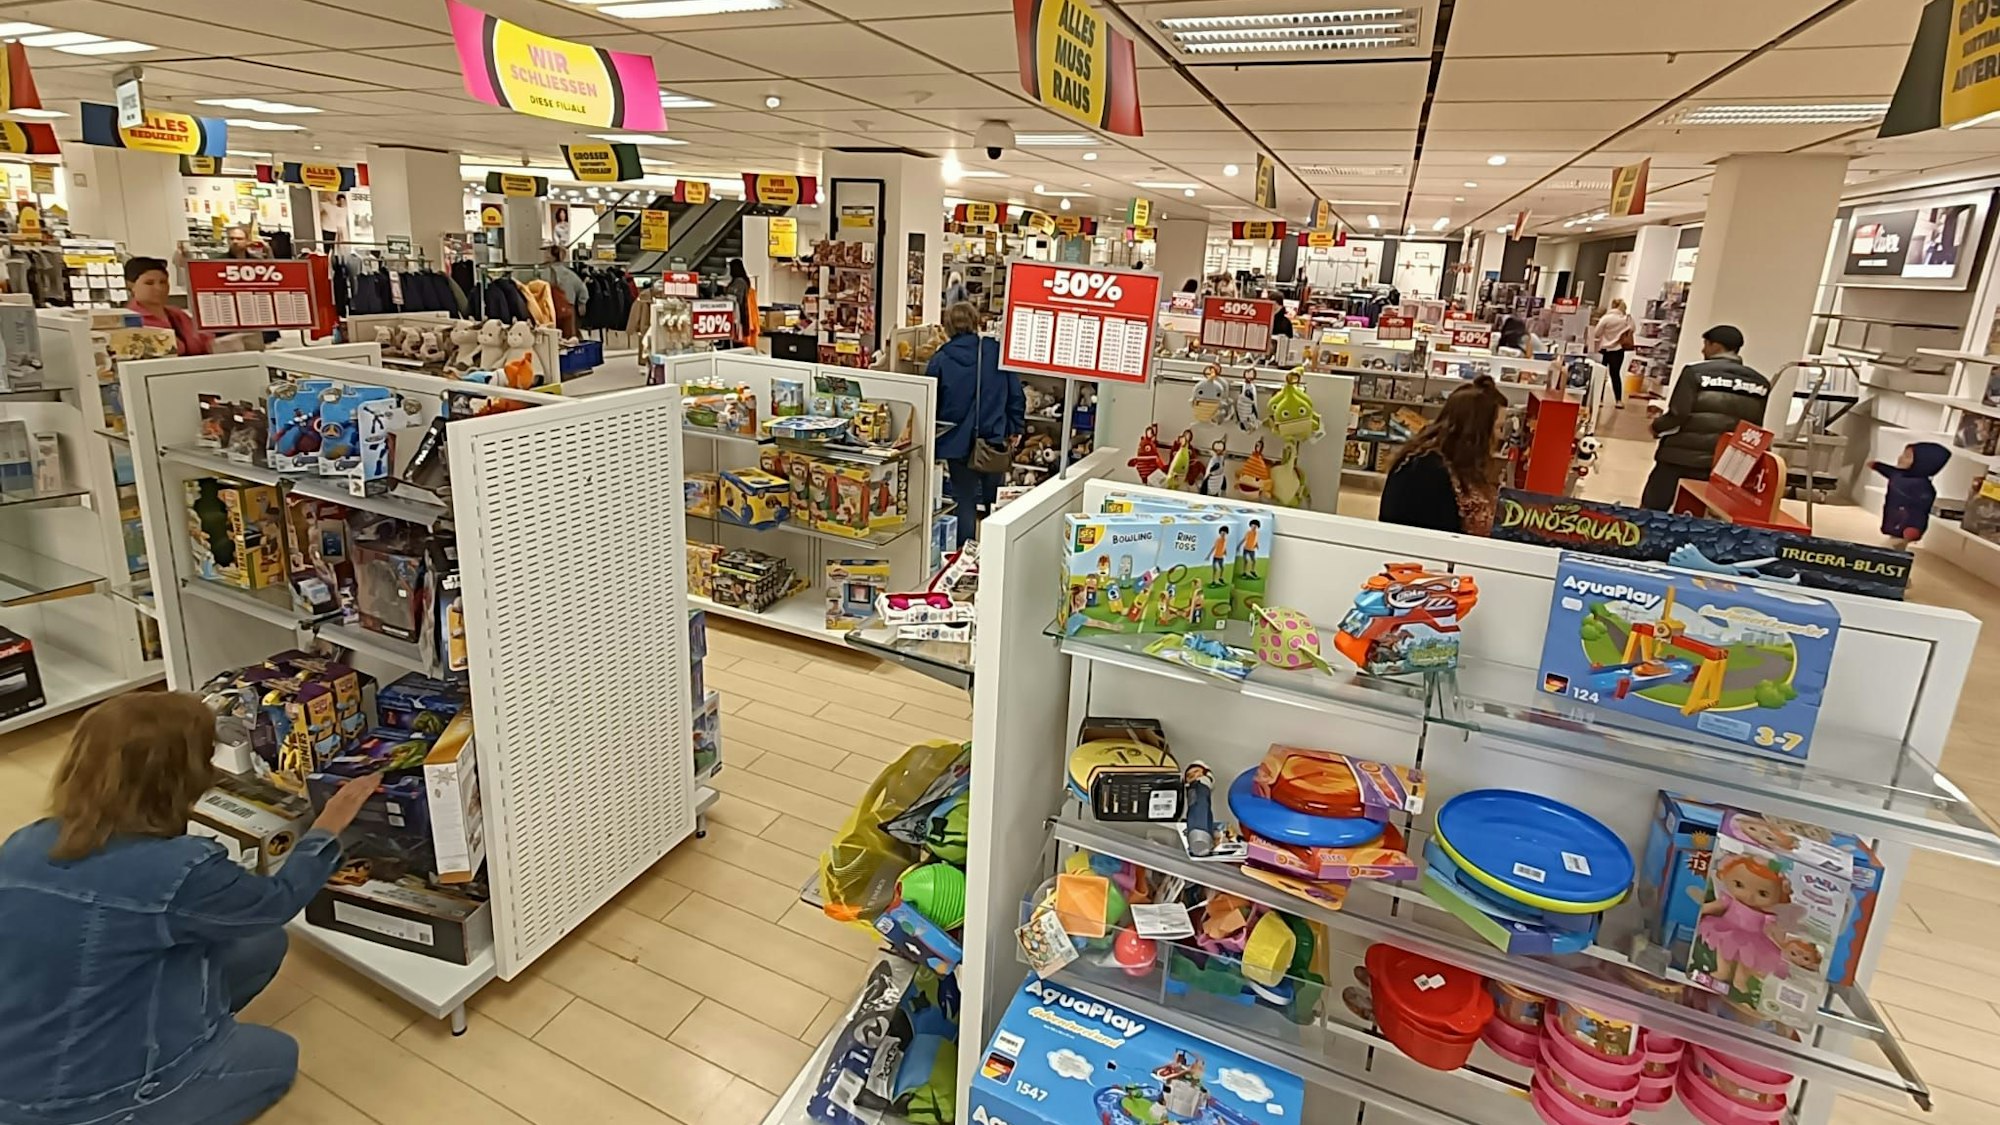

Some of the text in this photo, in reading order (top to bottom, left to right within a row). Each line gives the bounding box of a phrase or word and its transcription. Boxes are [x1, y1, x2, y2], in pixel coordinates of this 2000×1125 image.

[1058, 0, 1095, 48] ALLES
[527, 44, 570, 75] WIR
[1055, 34, 1091, 81] MUSS
[510, 64, 598, 98] SCHLIESSEN
[1053, 69, 1090, 114] RAUS
[530, 95, 587, 114] DIESE FILIALE
[139, 115, 188, 133] LLES
[130, 129, 189, 143] REDUZIERT
[306, 167, 336, 176] ALLES
[217, 265, 283, 282] -50%
[1043, 269, 1123, 301] -50%
[1219, 301, 1257, 317] -50%
[693, 314, 731, 334] -50%
[1455, 331, 1489, 345] -50%
[1500, 498, 1641, 547] DINOSQUAD
[1112, 531, 1153, 545] BOWLING
[1174, 541, 1196, 552] TOSS
[1176, 531, 1197, 543] RING
[1781, 546, 1906, 578] TRICERA-BLAST
[1563, 575, 1661, 609] AquaPlay
[1572, 686, 1599, 704] 124
[1754, 725, 1803, 751] 3-7
[1692, 858, 1706, 871] 13
[1025, 979, 1146, 1038] AquaPlay
[1016, 1080, 1048, 1102] 1547
